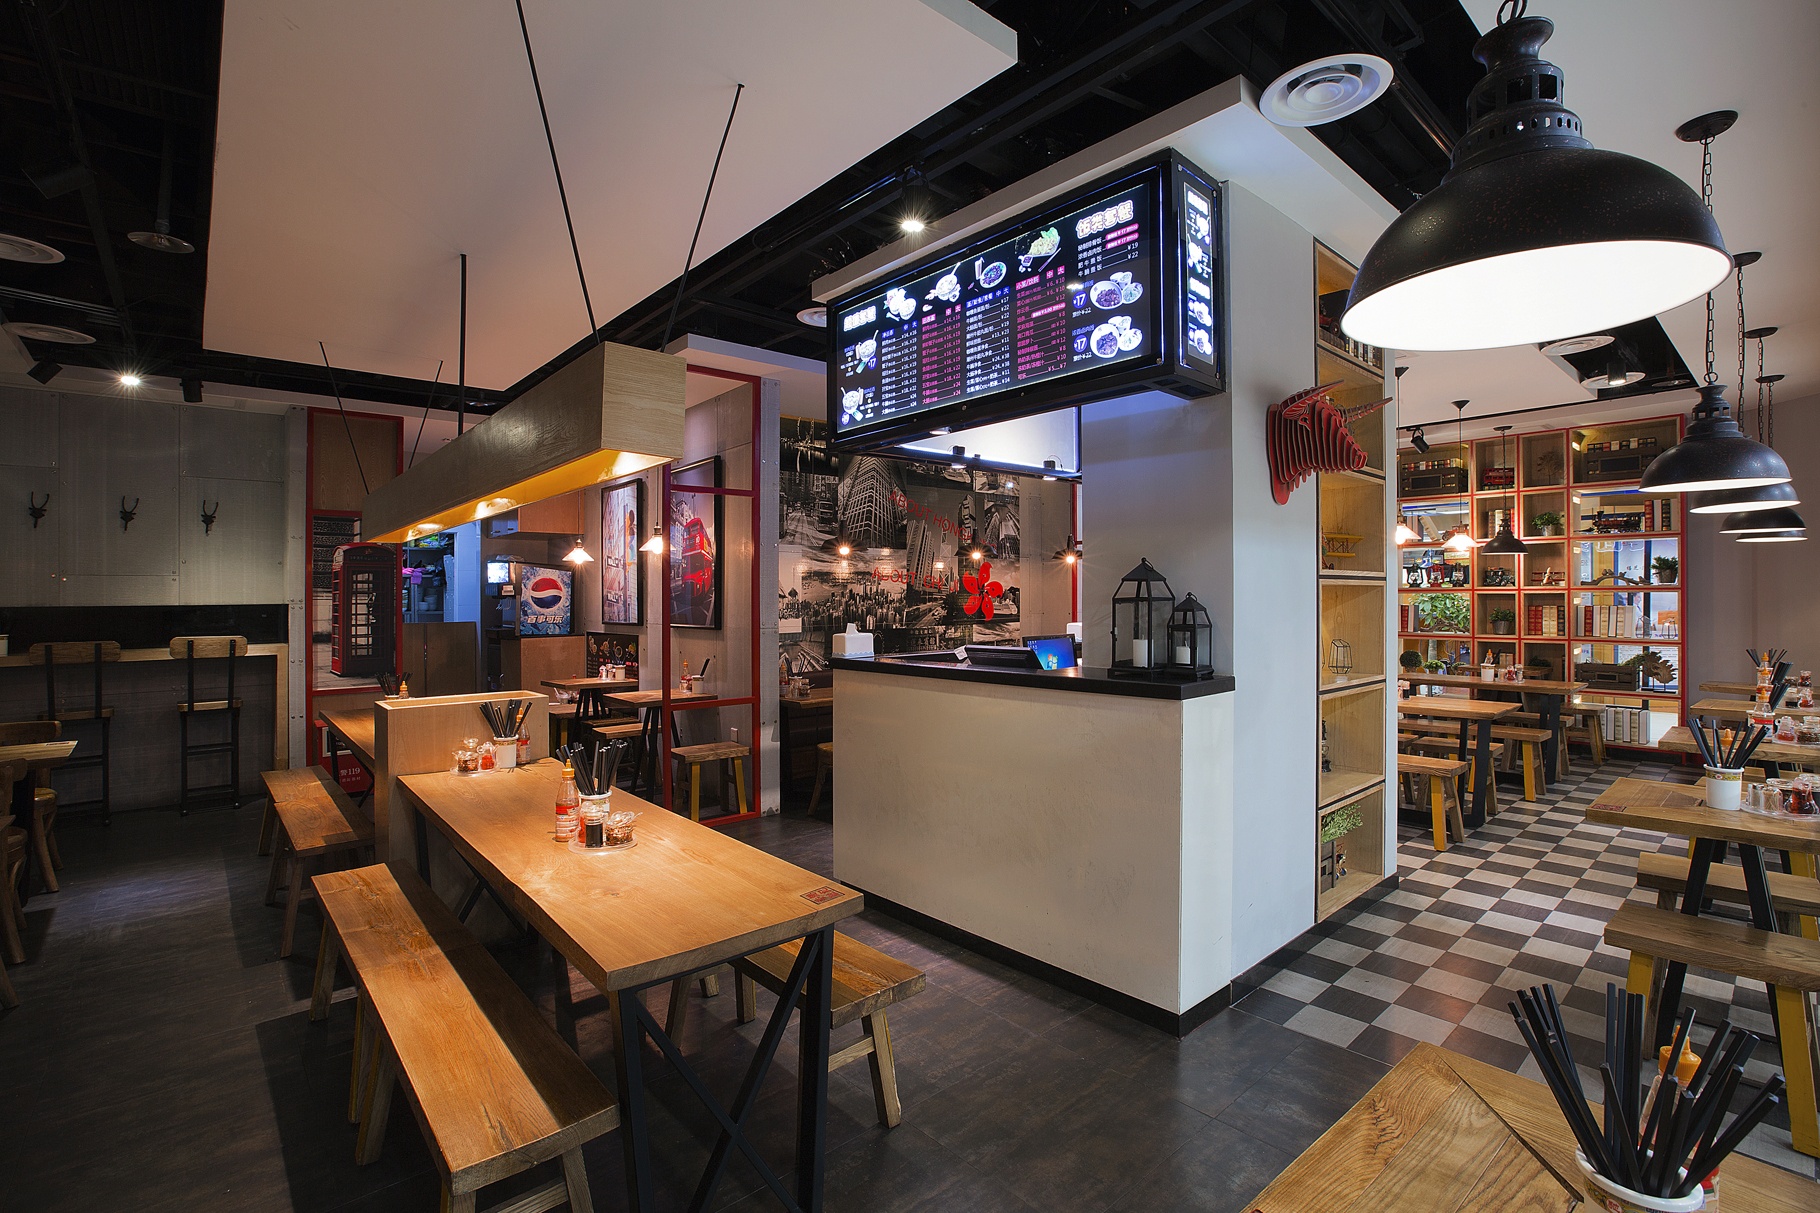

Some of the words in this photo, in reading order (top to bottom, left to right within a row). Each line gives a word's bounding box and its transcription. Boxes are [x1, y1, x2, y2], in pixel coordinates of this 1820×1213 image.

[1075, 199, 1134, 239] 饭类套餐
[1127, 241, 1139, 250] ¥19
[1127, 250, 1139, 260] ¥22
[1046, 269, 1053, 279] 中
[1057, 265, 1065, 275] 大
[1073, 293, 1087, 307] ¥17
[1073, 337, 1087, 351] ¥17
[888, 490, 932, 520] ABOUT
[527, 615, 564, 624] 百事可乐
[339, 767, 361, 776] 警119
